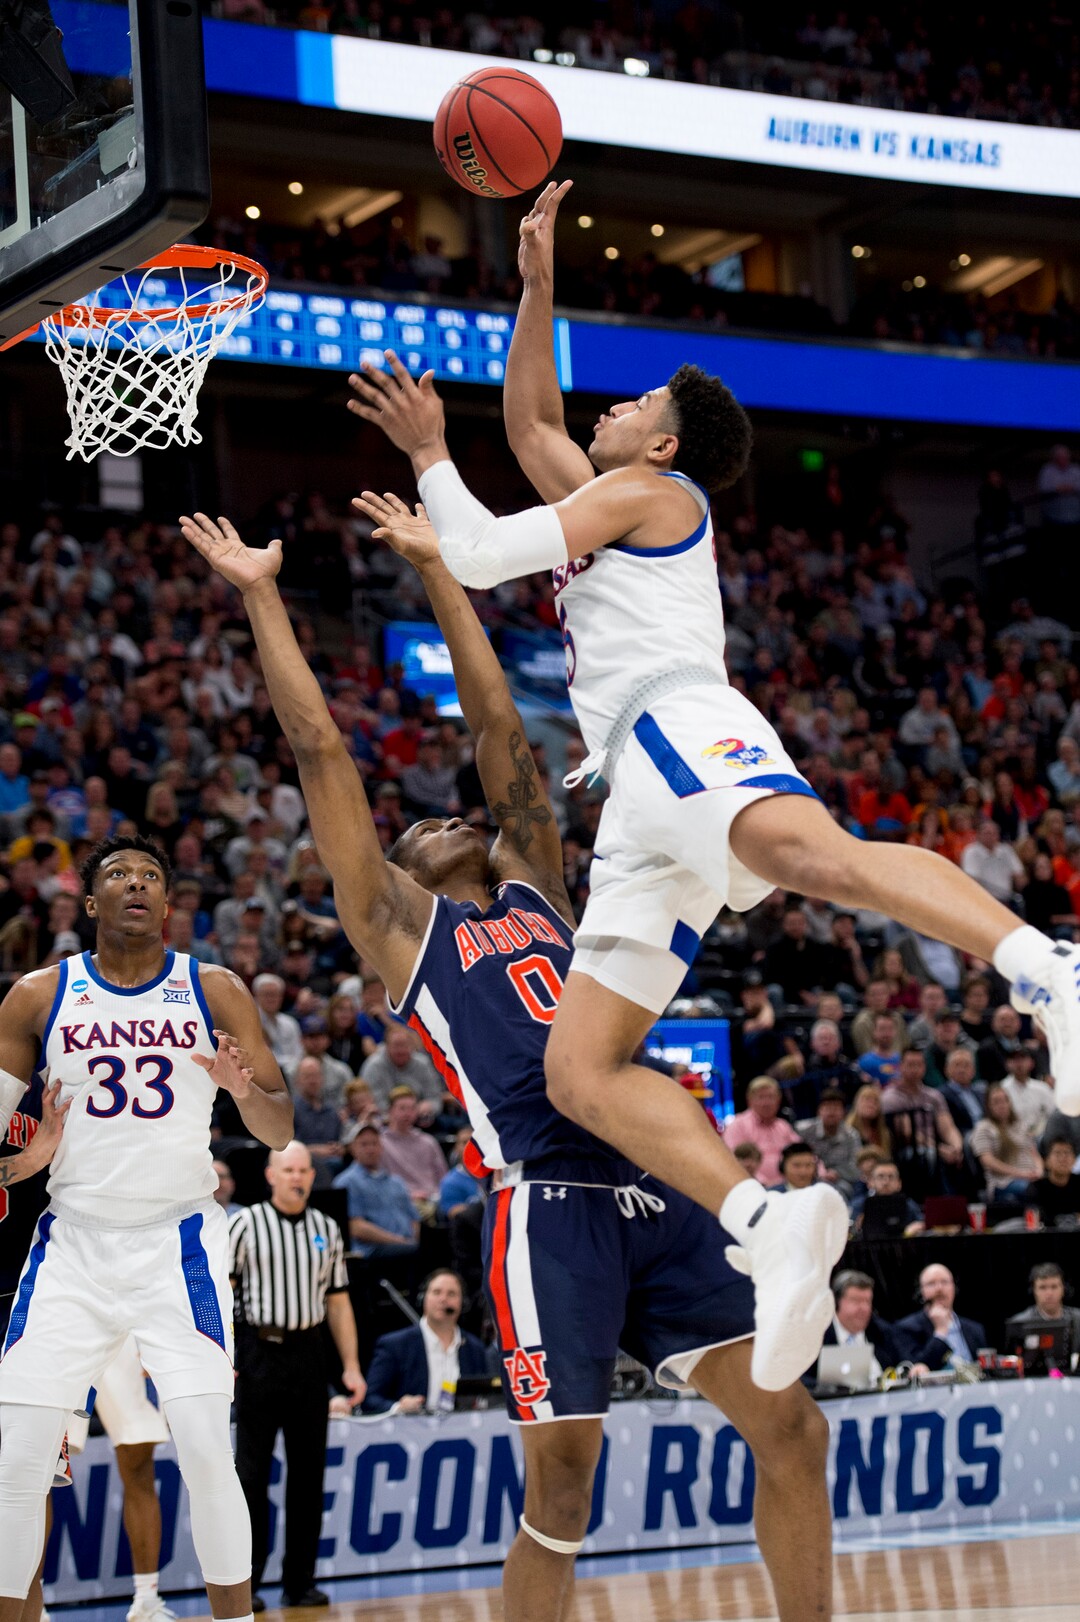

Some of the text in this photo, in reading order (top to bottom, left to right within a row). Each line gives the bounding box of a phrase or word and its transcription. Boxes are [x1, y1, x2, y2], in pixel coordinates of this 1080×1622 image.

[453, 131, 504, 198] Wilson
[768, 116, 1001, 168] AUBURN VS KANSAS
[553, 552, 595, 597] SAS
[454, 908, 570, 972] AUBURN
[60, 1019, 198, 1053] KANSAS
[86, 1054, 174, 1119] 33
[43, 1406, 1003, 1584] ND ECON RONDS
